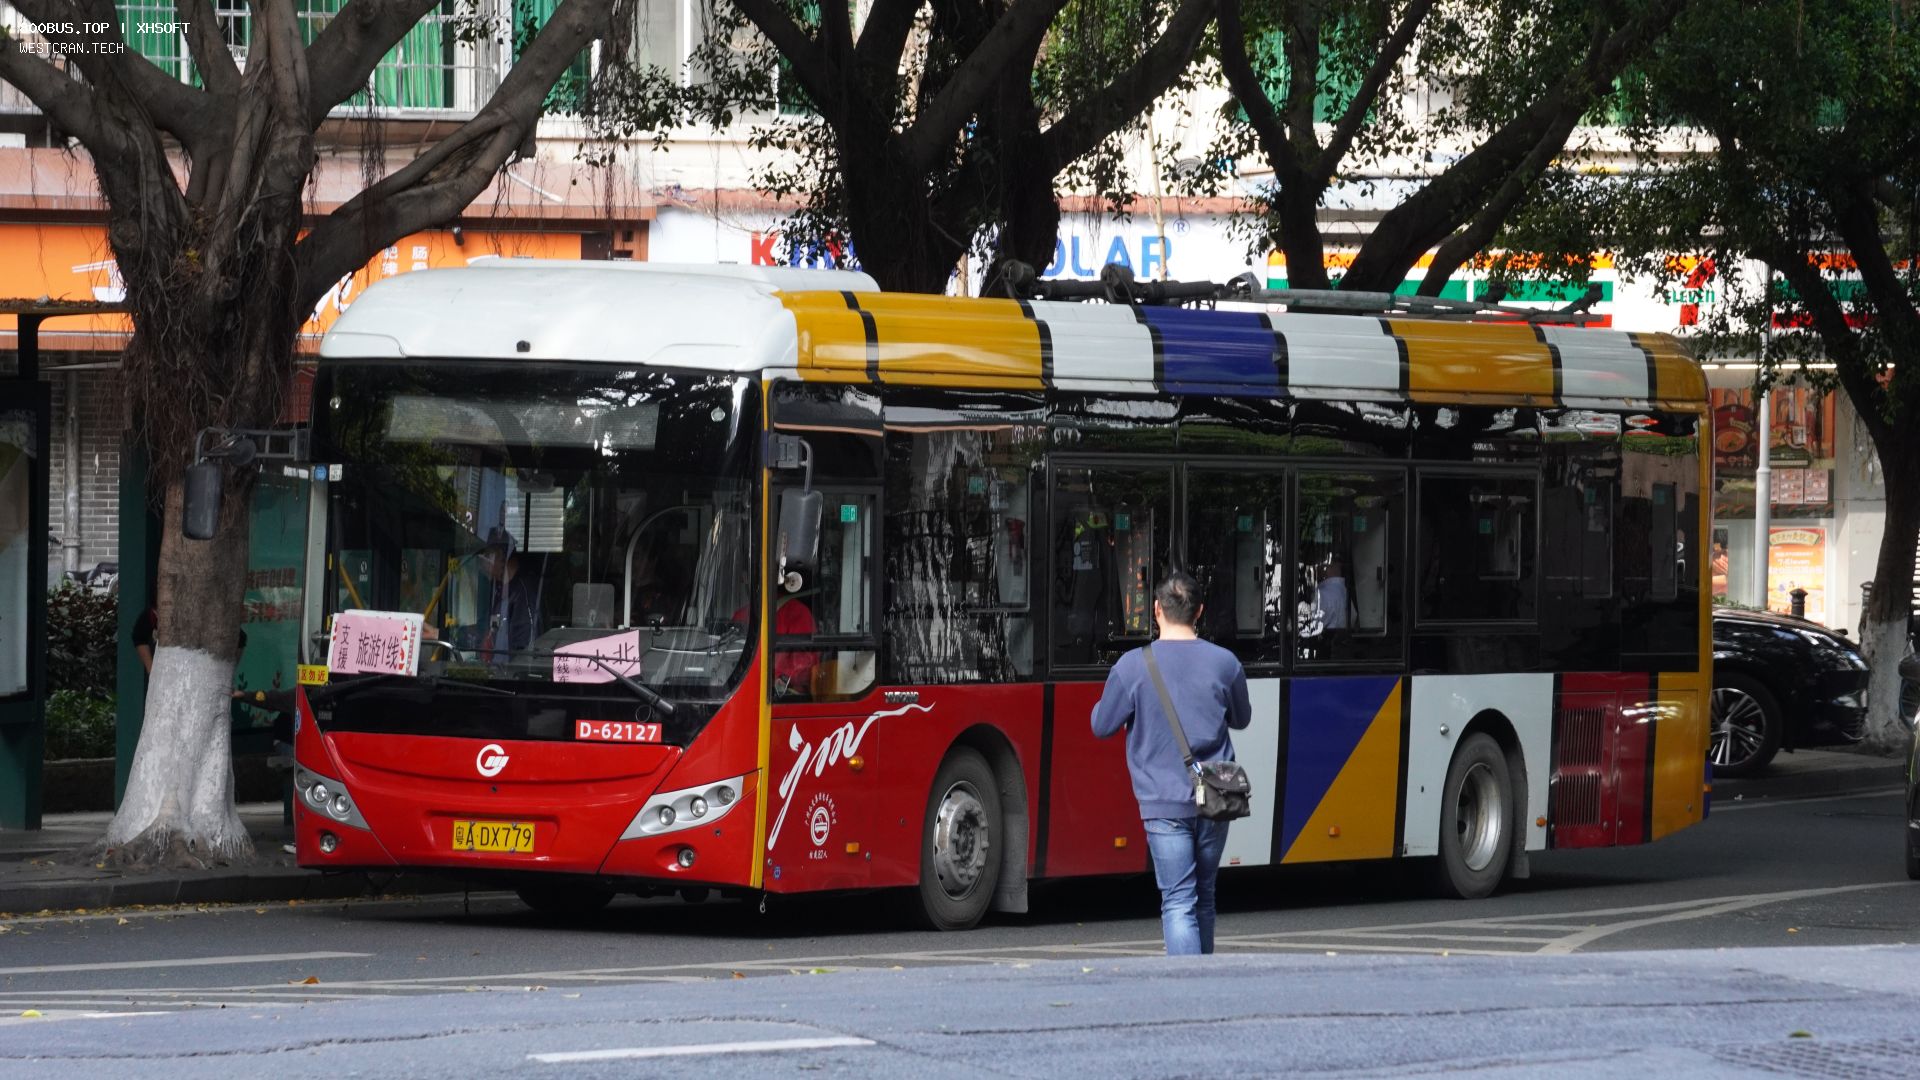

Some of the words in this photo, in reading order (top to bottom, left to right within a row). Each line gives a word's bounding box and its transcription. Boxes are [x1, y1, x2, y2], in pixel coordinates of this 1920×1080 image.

[337, 624, 351, 669] 支援
[356, 631, 400, 670] 旅游1线
[579, 721, 657, 741] D-62127
